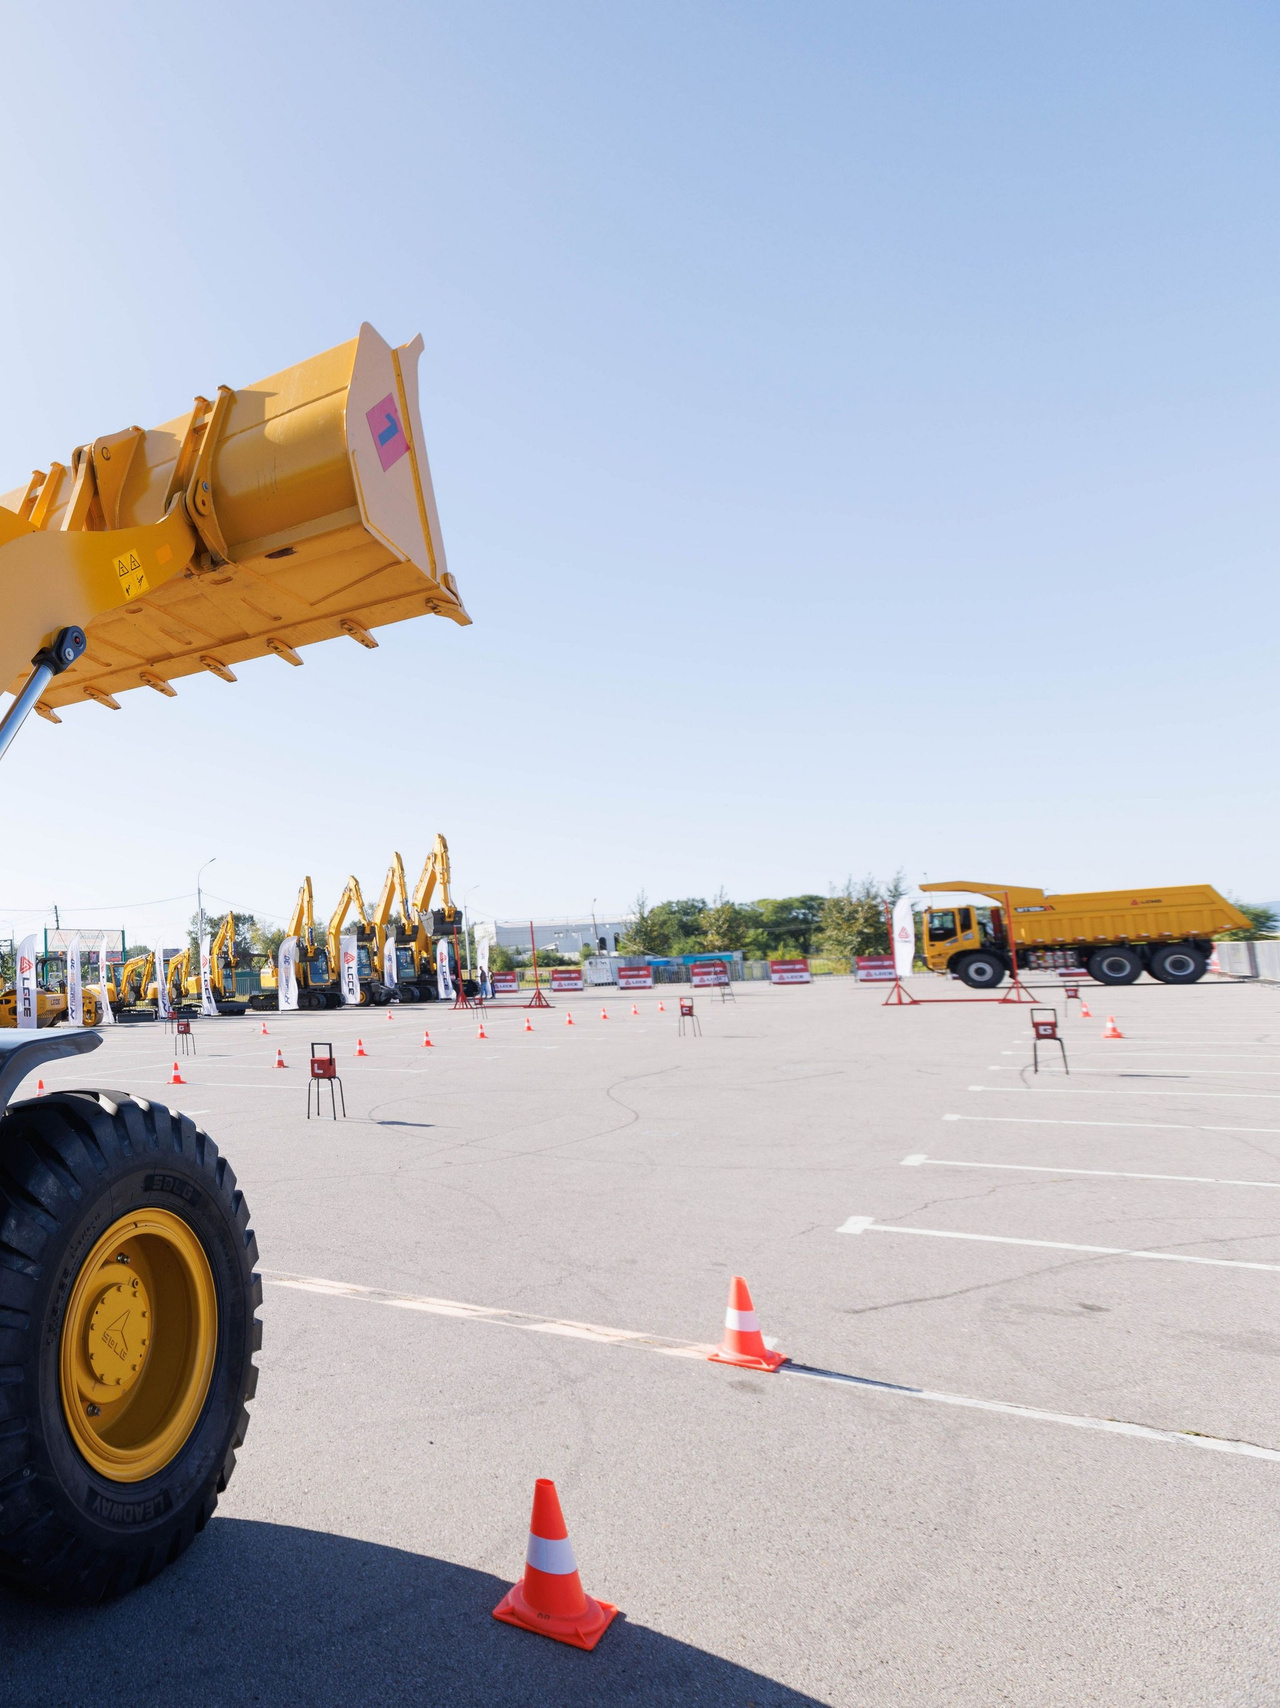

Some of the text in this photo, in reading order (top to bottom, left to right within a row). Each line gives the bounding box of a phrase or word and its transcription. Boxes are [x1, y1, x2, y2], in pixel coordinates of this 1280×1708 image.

[378, 413, 400, 447] 1
[314, 1063, 324, 1074] L
[151, 1175, 194, 1199] SDLG
[91, 1494, 165, 1522] LEADWAY
